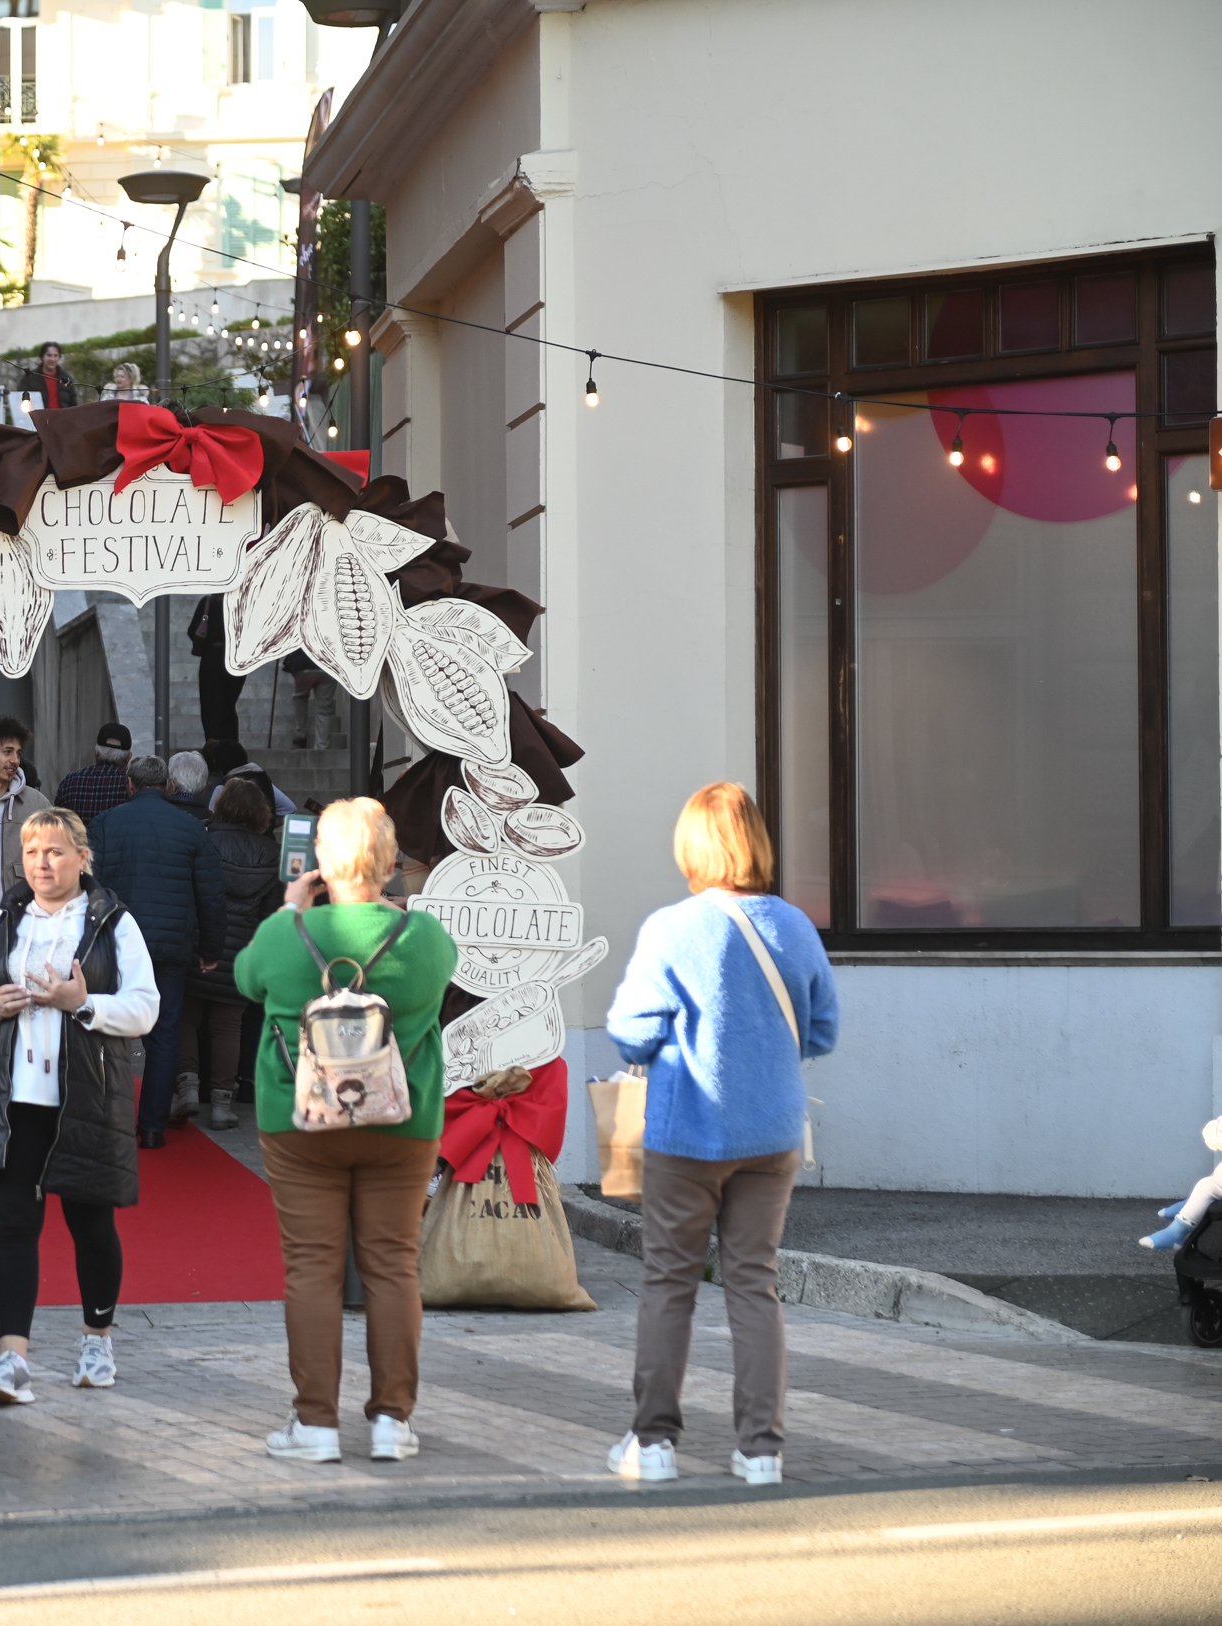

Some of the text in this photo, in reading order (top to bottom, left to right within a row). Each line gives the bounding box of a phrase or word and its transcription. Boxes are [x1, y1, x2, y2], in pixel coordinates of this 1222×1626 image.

[40, 488, 235, 526] CHOCOLATE
[60, 535, 213, 574] FESTIVAL
[468, 856, 537, 878] FINEST
[460, 961, 523, 986] QUALITY
